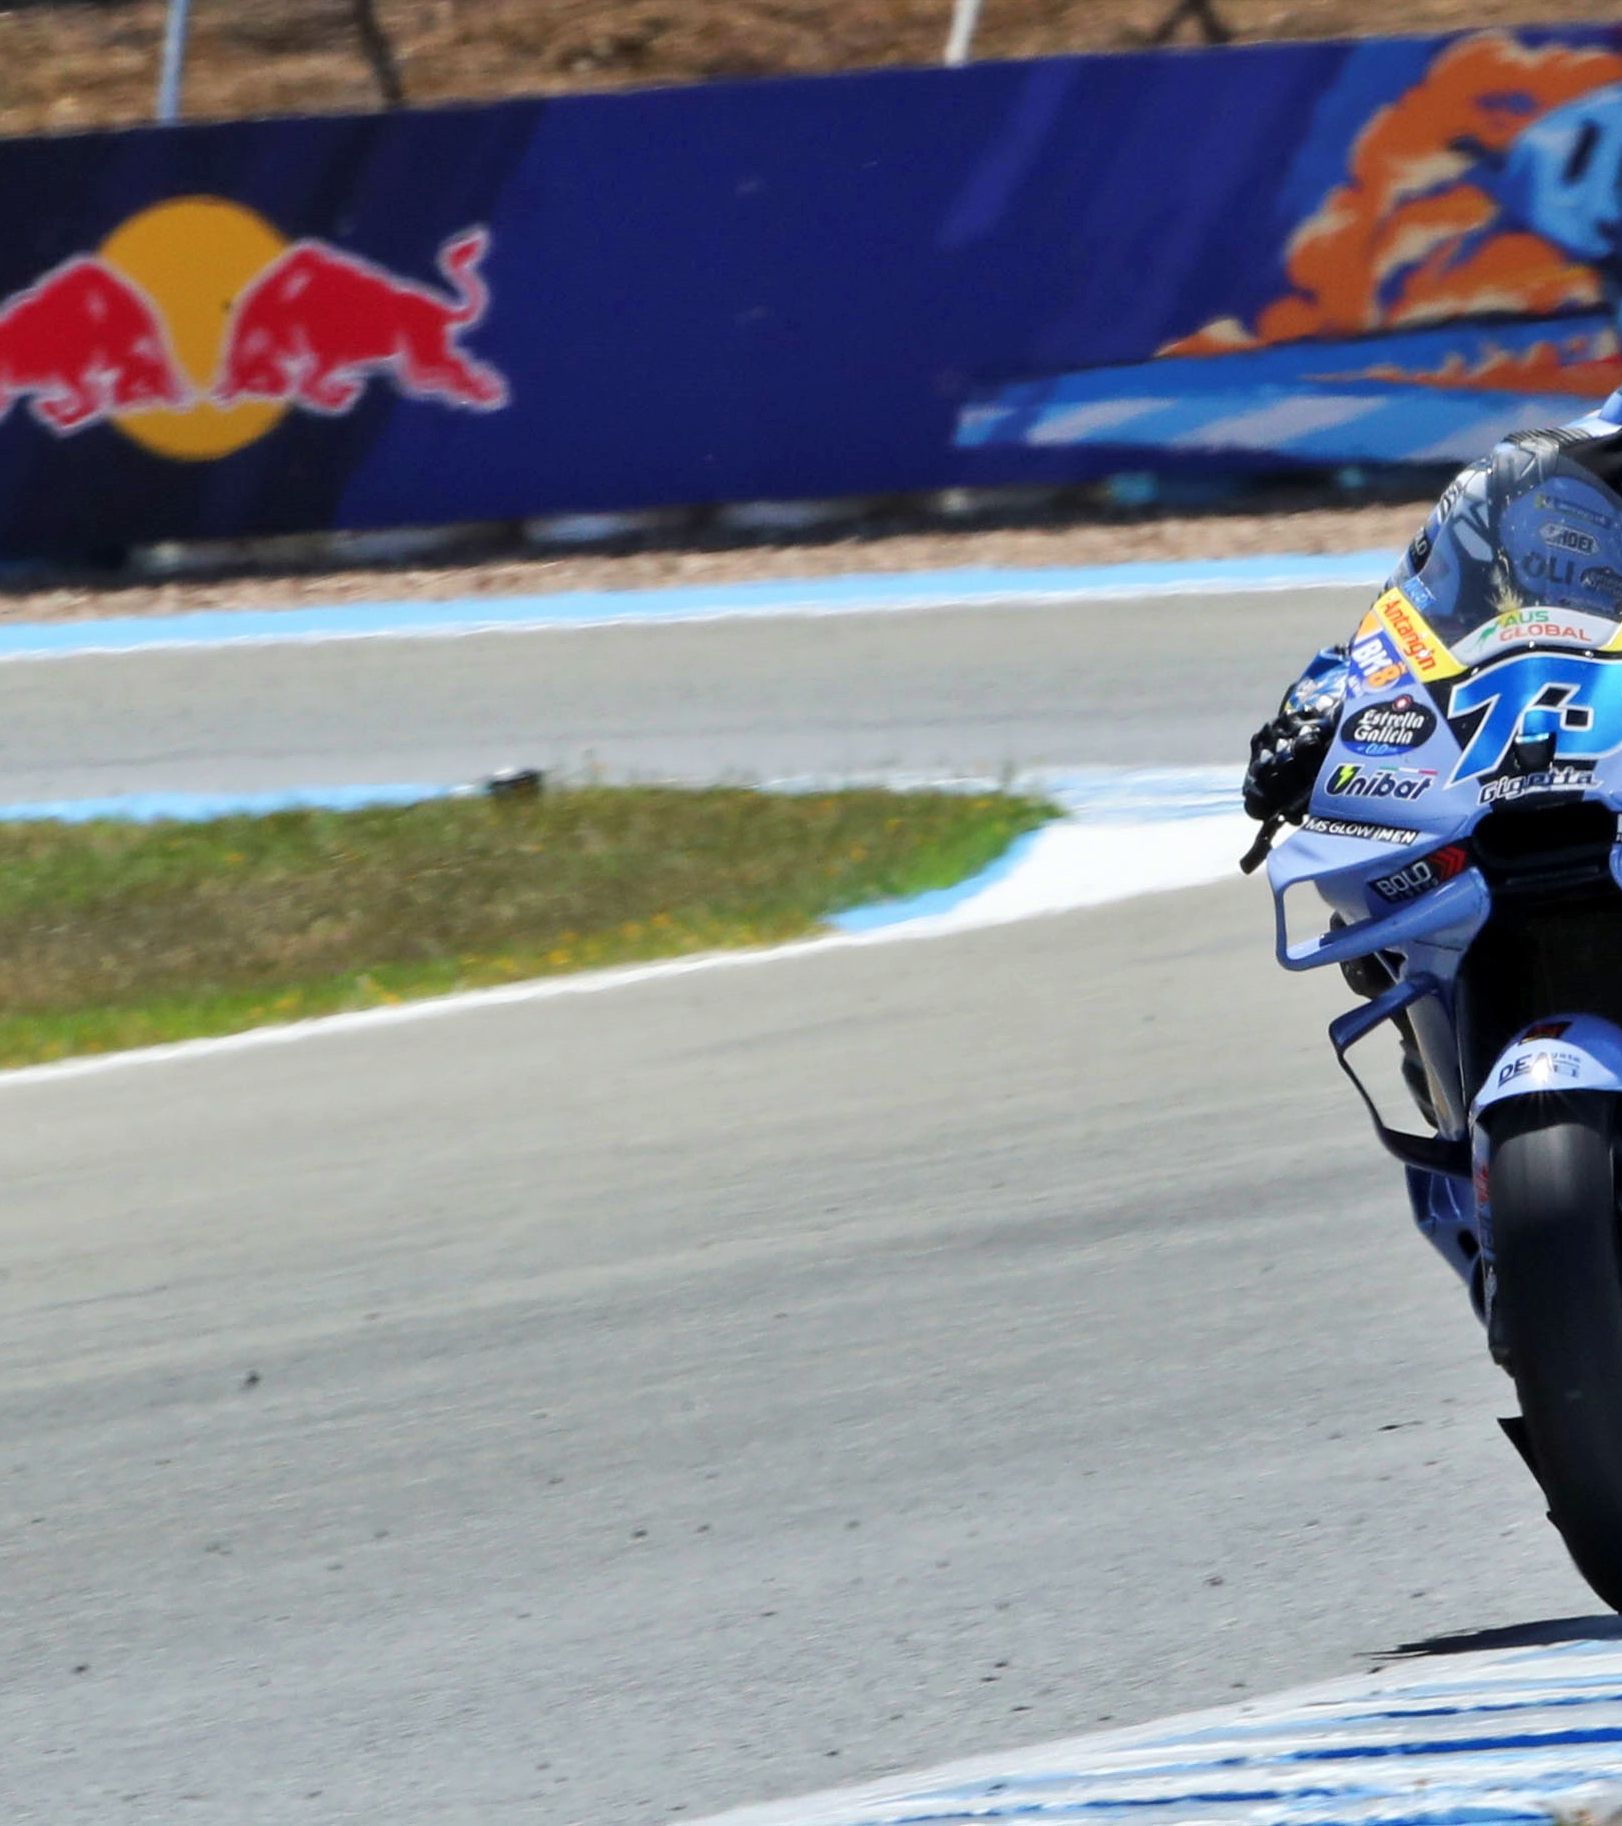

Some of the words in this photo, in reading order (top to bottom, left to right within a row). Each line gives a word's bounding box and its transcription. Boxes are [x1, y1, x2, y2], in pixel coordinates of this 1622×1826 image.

[1503, 610, 1550, 628] AUS
[1500, 623, 1592, 643] GLOBAL
[1351, 637, 1407, 690] BK8
[1357, 708, 1425, 730] Estrella
[1353, 725, 1414, 745] Galicia
[1325, 763, 1434, 801] Unibat
[1305, 817, 1328, 834] MS
[1328, 822, 1375, 839] GLOW
[1376, 861, 1432, 896] BOLD
